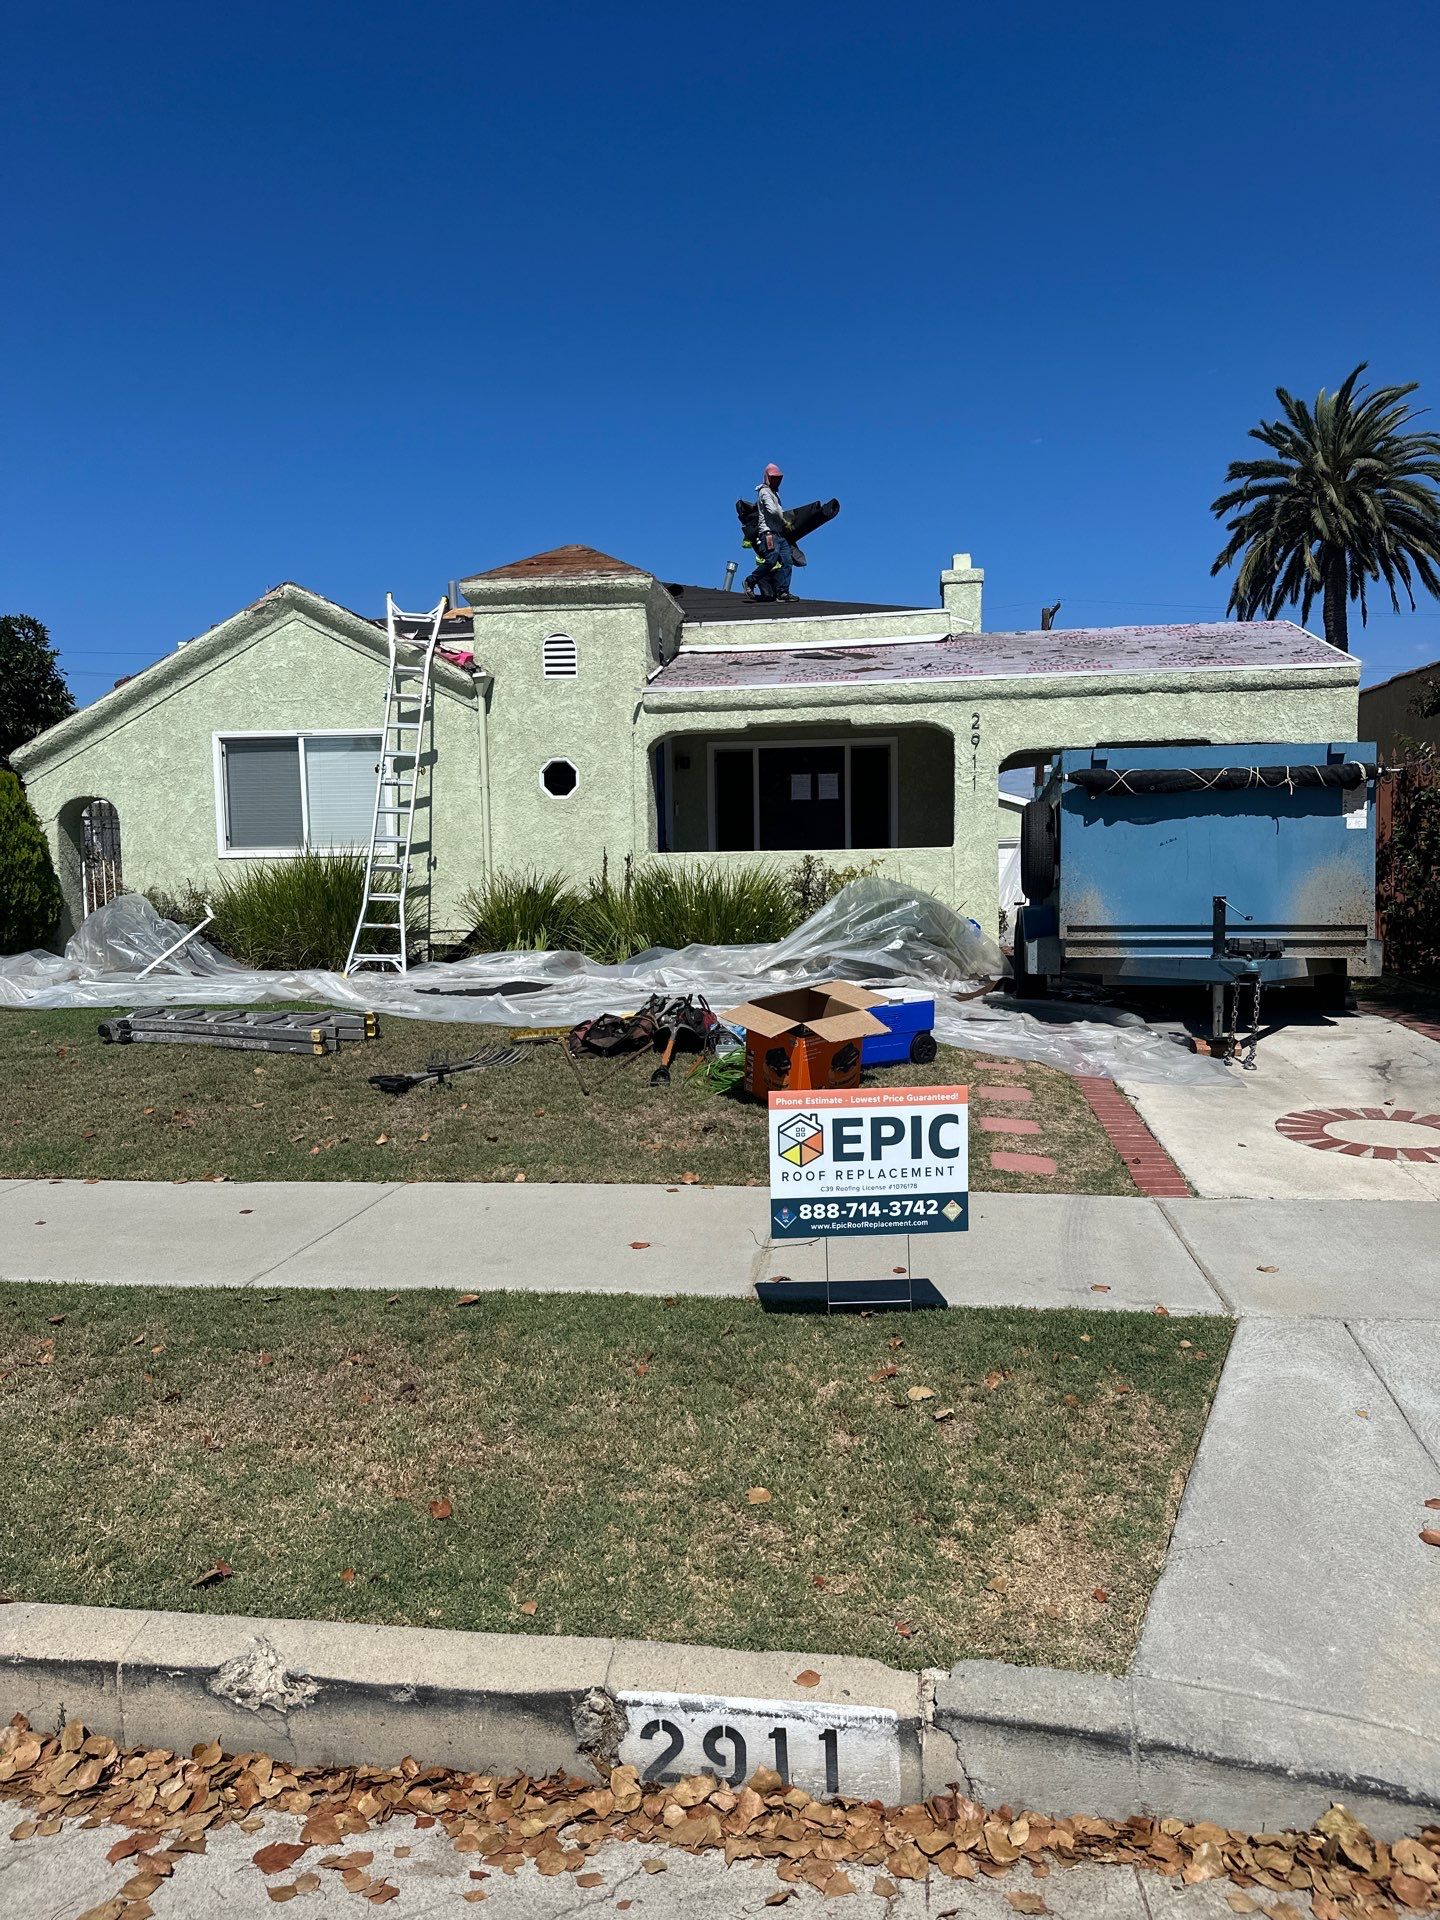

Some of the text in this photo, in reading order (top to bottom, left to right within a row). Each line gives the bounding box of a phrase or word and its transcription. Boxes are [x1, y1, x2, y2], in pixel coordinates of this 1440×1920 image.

[971, 712, 980, 791] 2911
[776, 1097, 803, 1106] Phone
[805, 1096, 842, 1105] Estimate
[850, 1095, 881, 1104] Lowest
[883, 1094, 904, 1103] Price
[906, 1092, 959, 1102] Guaranteed!
[832, 1113, 960, 1162] EPIC
[781, 1166, 955, 1182] ROOF REPLACEMENT
[836, 1185, 860, 1193] Roofing
[888, 1182, 918, 1190] #1076178
[799, 1199, 939, 1220] 888-714-3742
[811, 1219, 929, 1231] www.EpicRoofReplacement.com
[639, 1718, 839, 1794] 2911
